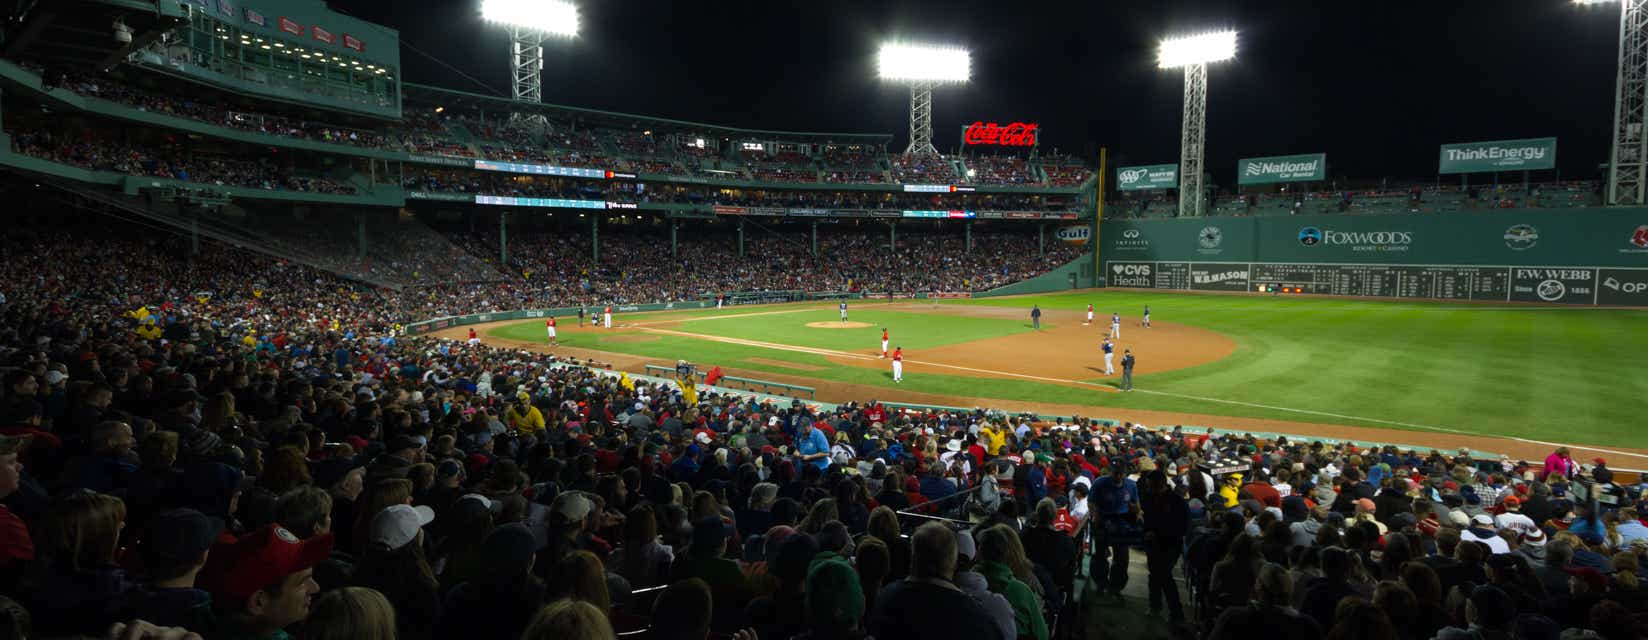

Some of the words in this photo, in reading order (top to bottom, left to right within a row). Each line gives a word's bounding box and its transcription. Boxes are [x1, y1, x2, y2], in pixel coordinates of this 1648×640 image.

[965, 121, 1038, 147] Coca-Cola
[1447, 147, 1545, 160] ThinkEnergy
[1261, 160, 1318, 173] National
[1058, 230, 1088, 238] Gulf
[1324, 231, 1412, 244] FOXWOODS
[1124, 265, 1151, 275] CVS
[1546, 270, 1591, 280] WEBB
[1113, 275, 1150, 286] Health
